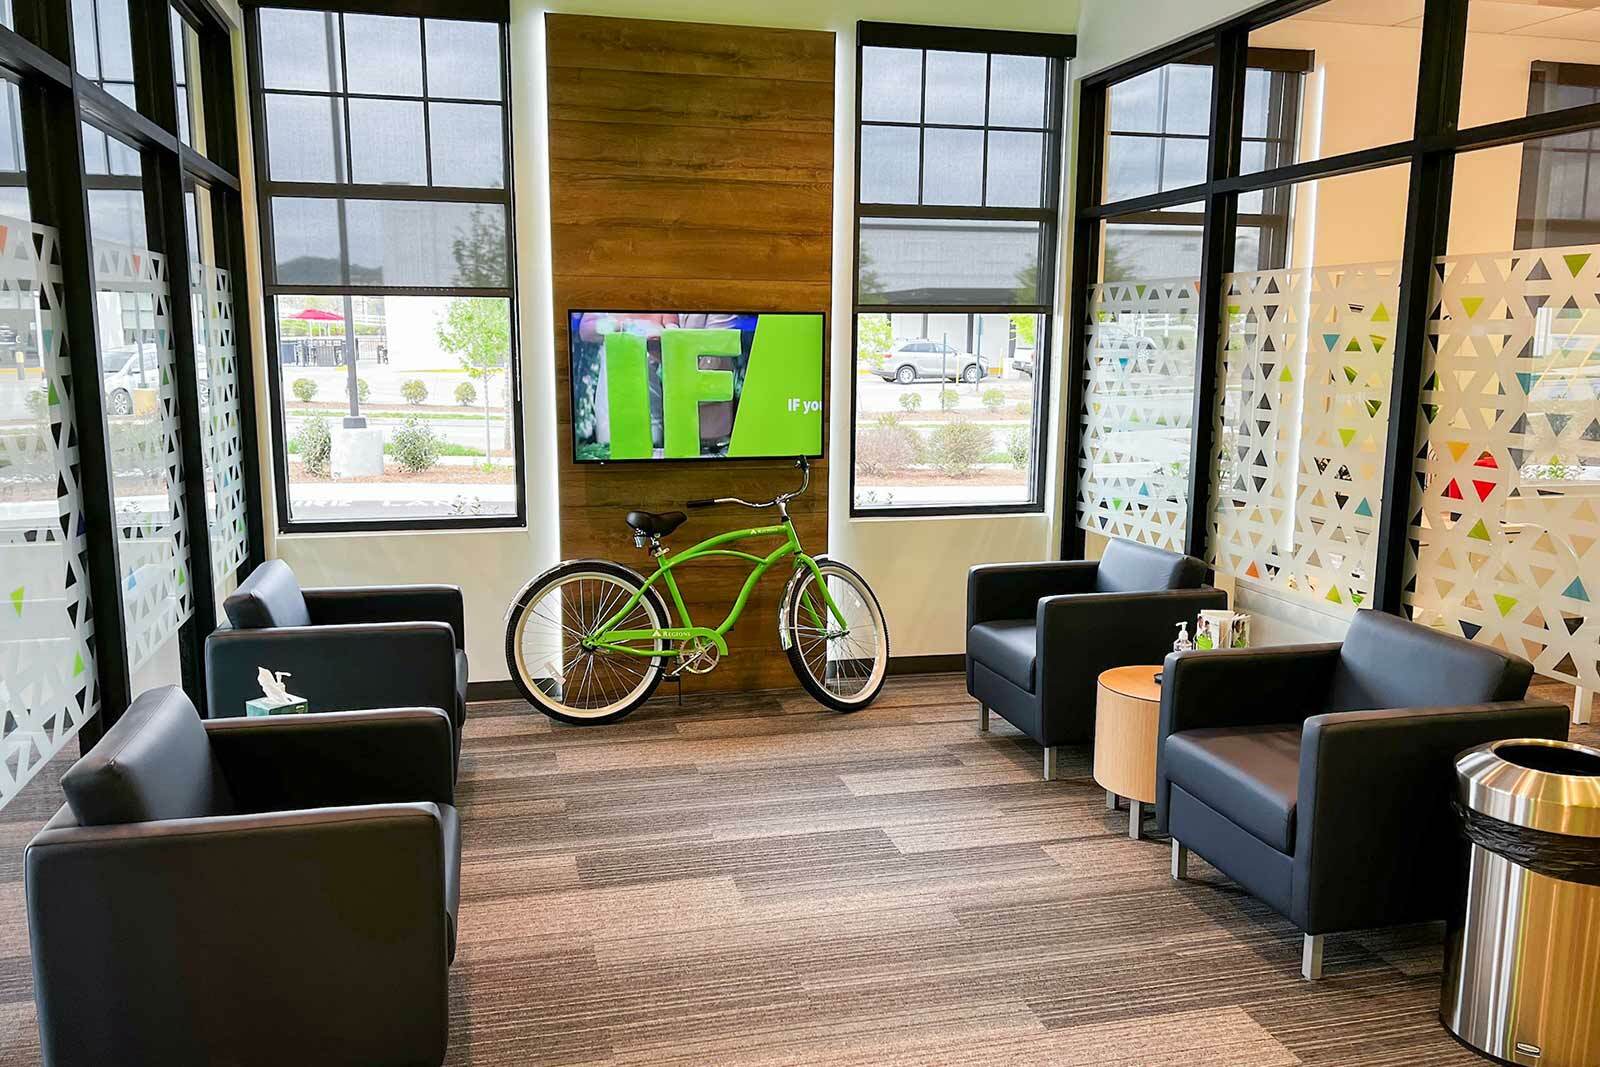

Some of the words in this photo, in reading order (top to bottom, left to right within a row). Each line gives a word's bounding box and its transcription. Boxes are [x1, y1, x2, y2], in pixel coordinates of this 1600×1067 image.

[603, 328, 742, 459] IF
[788, 398, 800, 411] IF
[662, 630, 691, 638] REGIONS
